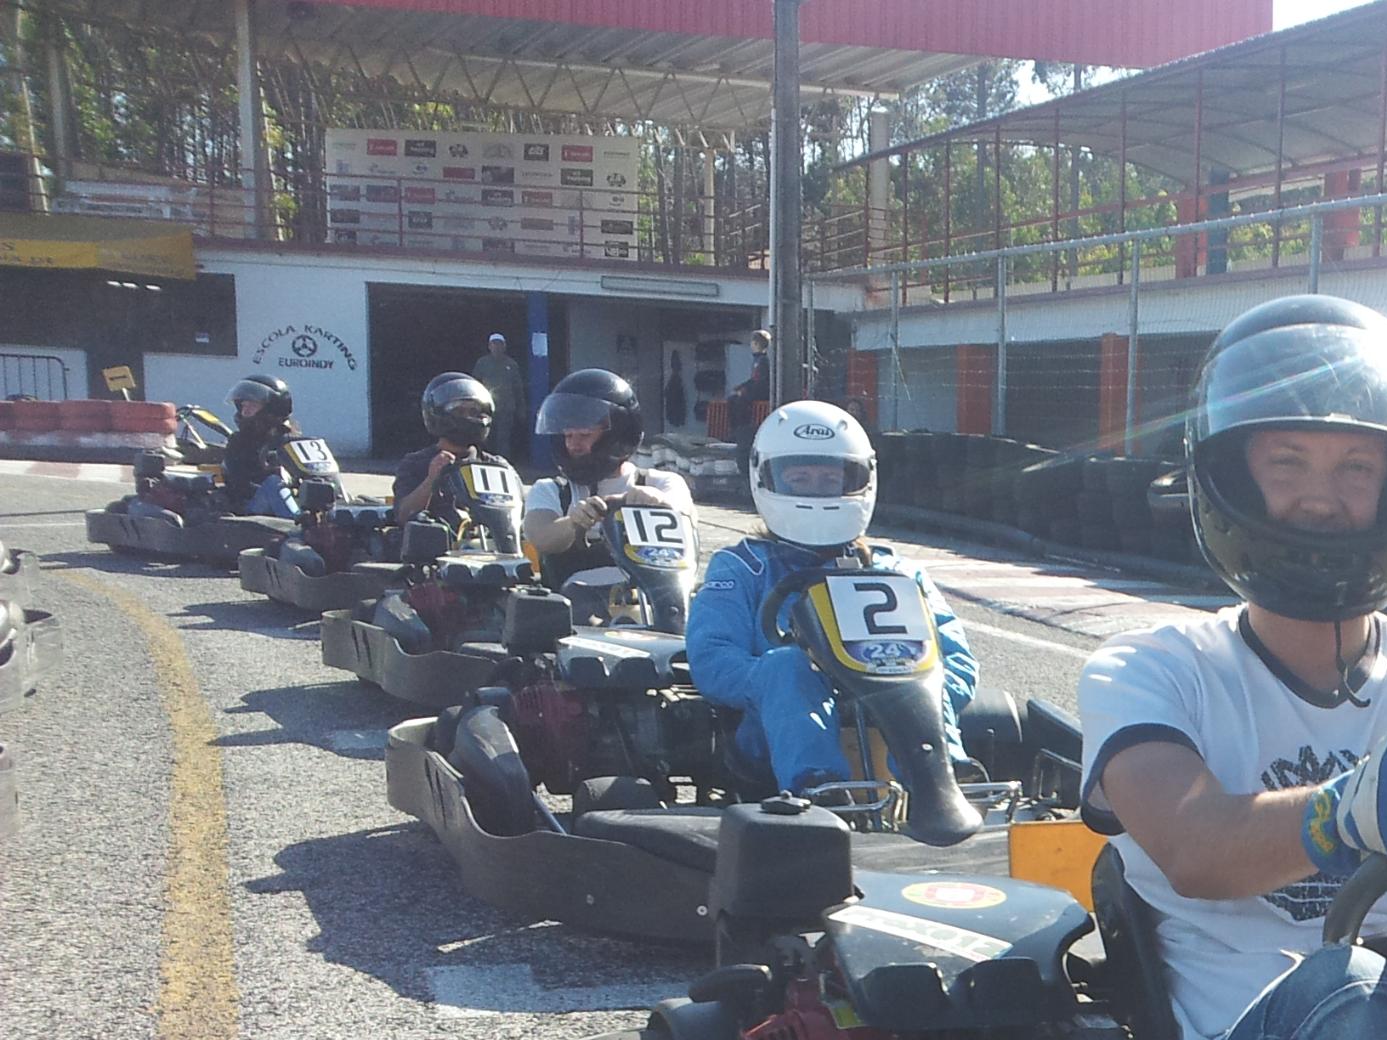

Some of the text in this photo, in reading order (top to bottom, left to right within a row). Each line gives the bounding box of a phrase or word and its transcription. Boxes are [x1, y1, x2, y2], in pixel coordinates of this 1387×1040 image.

[253, 324, 357, 371] ESCOLA KARTING
[278, 357, 334, 369] EUROINDY
[297, 440, 328, 461] 13
[480, 468, 510, 494] 11
[632, 510, 683, 544] 12
[853, 583, 907, 635] 2
[869, 644, 901, 658] 24
